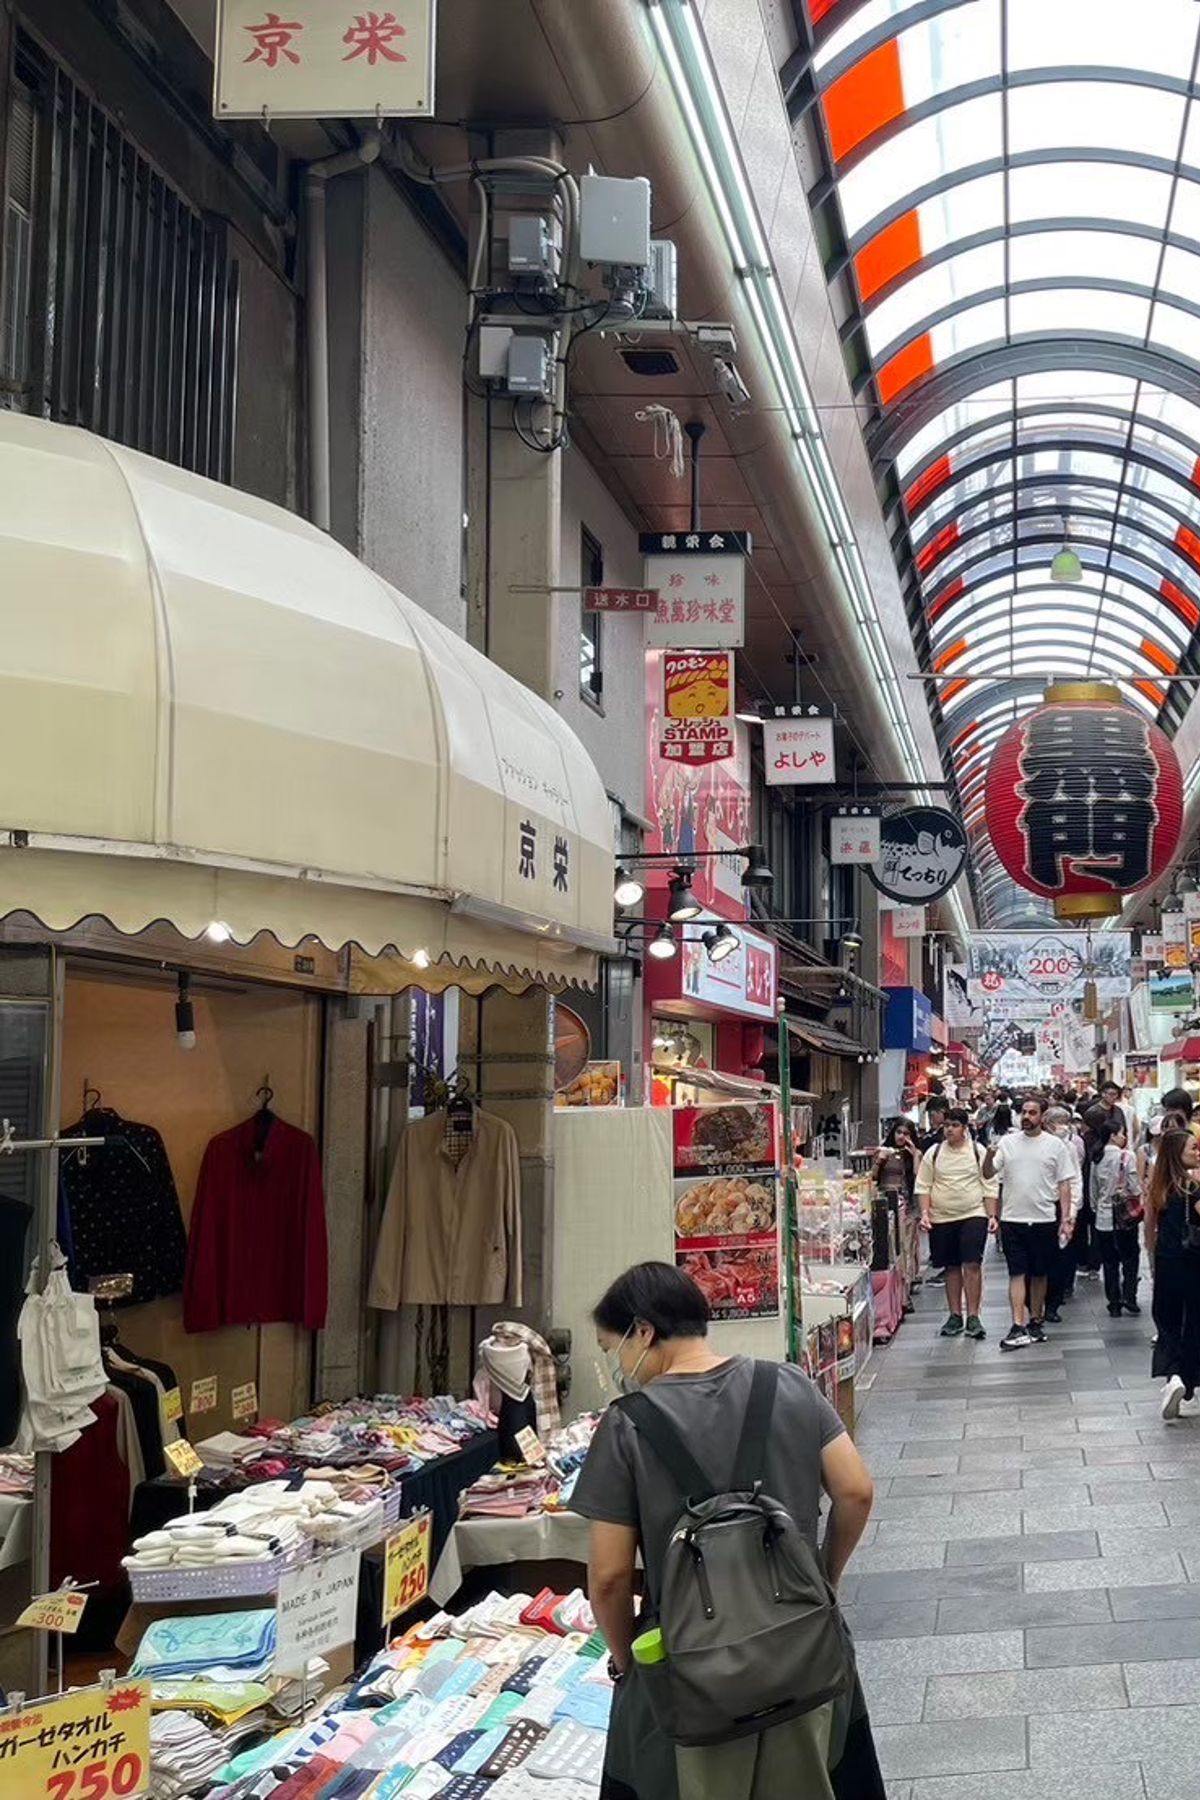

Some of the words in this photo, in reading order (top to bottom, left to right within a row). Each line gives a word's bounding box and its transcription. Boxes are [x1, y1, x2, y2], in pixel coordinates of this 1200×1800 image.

[242, 12, 407, 67] 京栄
[669, 573, 721, 588] 珍味
[594, 592, 650, 608] 送水口
[666, 657, 708, 674] クロモン
[664, 727, 729, 740] STAMP
[664, 742, 729, 757] 加盟店
[774, 750, 826, 769] よしや
[518, 819, 570, 893] 京栄
[281, 1593, 307, 1613] MADE
[311, 1588, 322, 1602] IN
[326, 1575, 355, 1596] JAPAN
[0, 1711, 113, 1759] ガーゼタオル
[51, 1731, 127, 1769] ハンカチ
